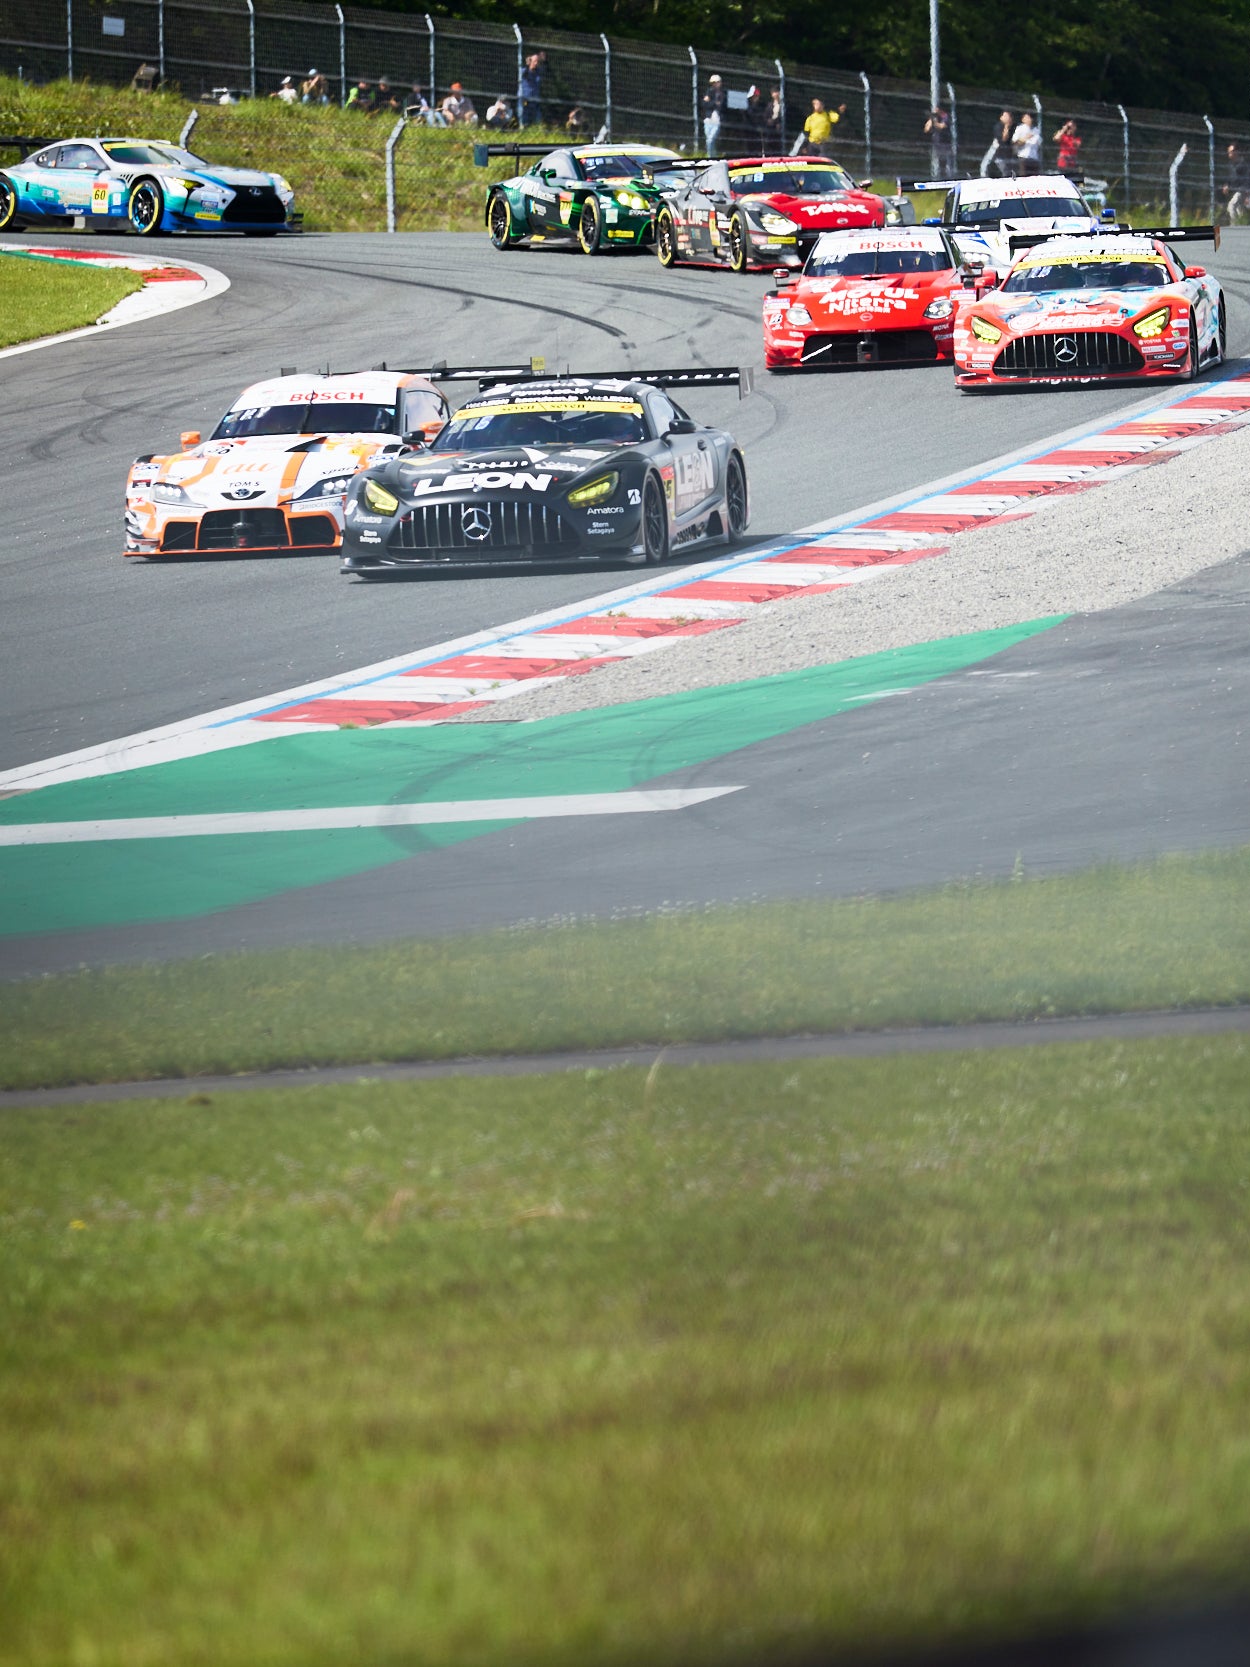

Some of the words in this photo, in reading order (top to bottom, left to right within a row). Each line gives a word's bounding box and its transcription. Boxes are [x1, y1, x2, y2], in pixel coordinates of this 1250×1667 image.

[94, 190, 106, 200] 60
[1004, 189, 1057, 198] BOSCH
[859, 240, 922, 249] BOSCH
[819, 287, 920, 304] MOTUL
[828, 296, 907, 313] Niterra
[289, 392, 364, 402] BOSCH
[414, 472, 552, 496] LEON
[587, 506, 625, 515] Amatora
[587, 527, 615, 535] Setagaya
